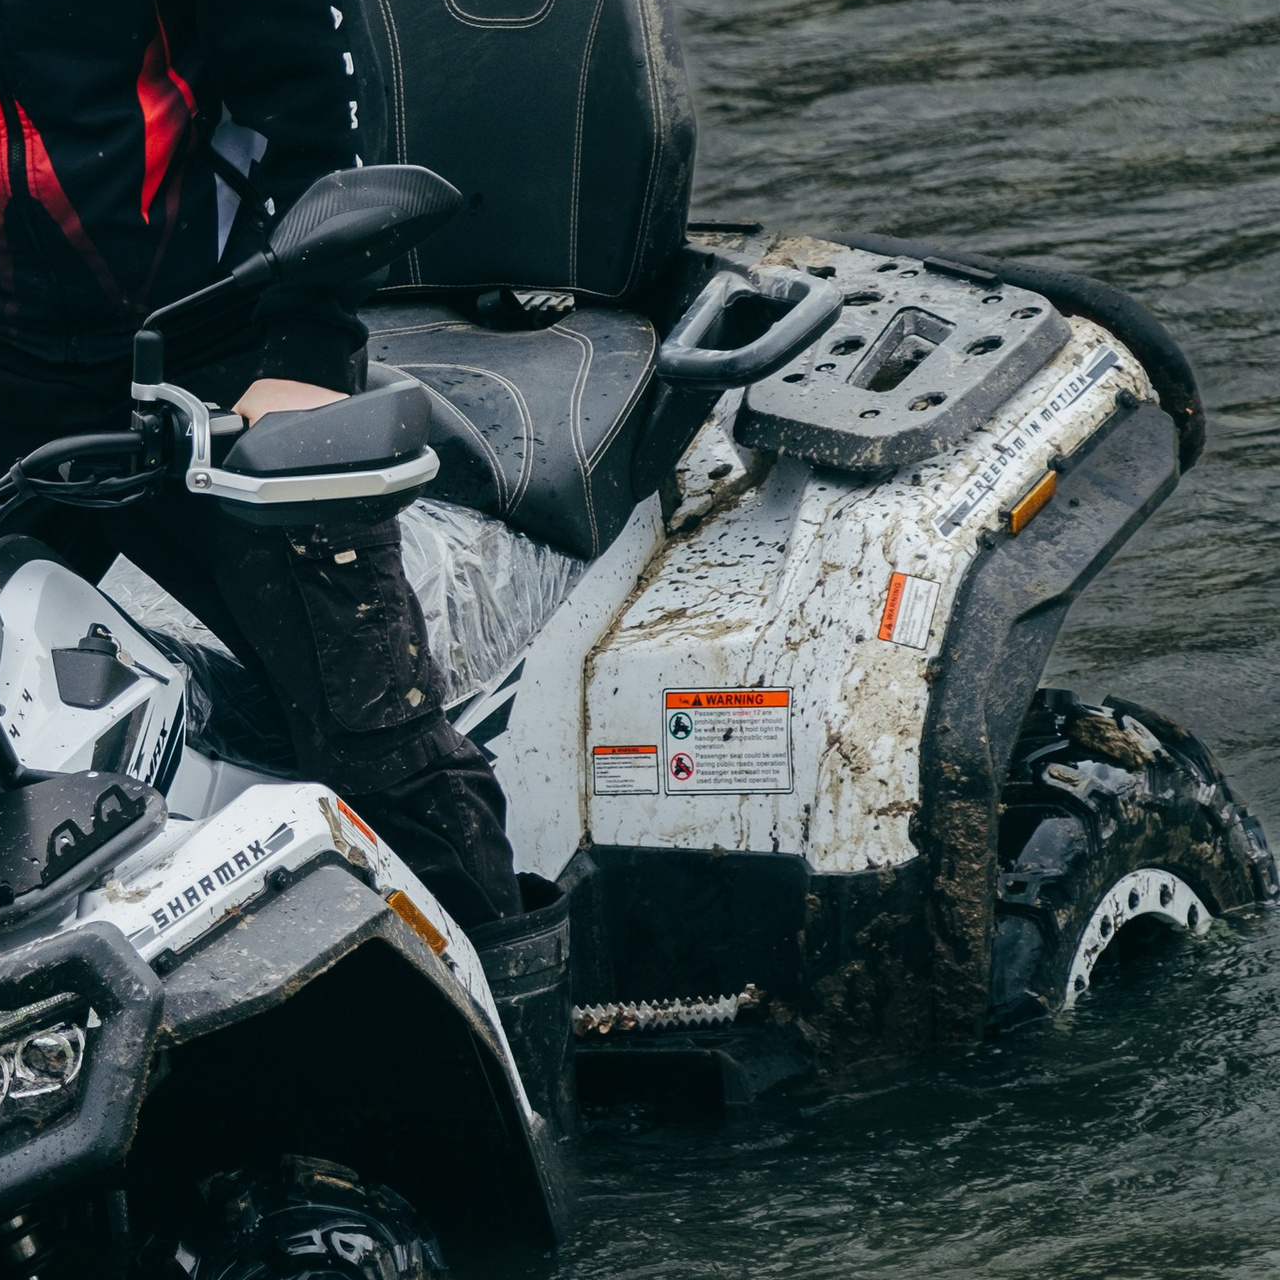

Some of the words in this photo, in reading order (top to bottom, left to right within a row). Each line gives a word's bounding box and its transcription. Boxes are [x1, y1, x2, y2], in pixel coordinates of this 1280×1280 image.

[965, 436, 1027, 501] FREEDOM
[1025, 420, 1042, 438] IN
[1040, 373, 1089, 422] MOTION
[886, 582, 902, 620] WARNING
[705, 693, 764, 706] WARNING
[716, 760, 735, 768] public
[713, 777, 732, 785] during
[150, 839, 267, 929] SHARMAX
